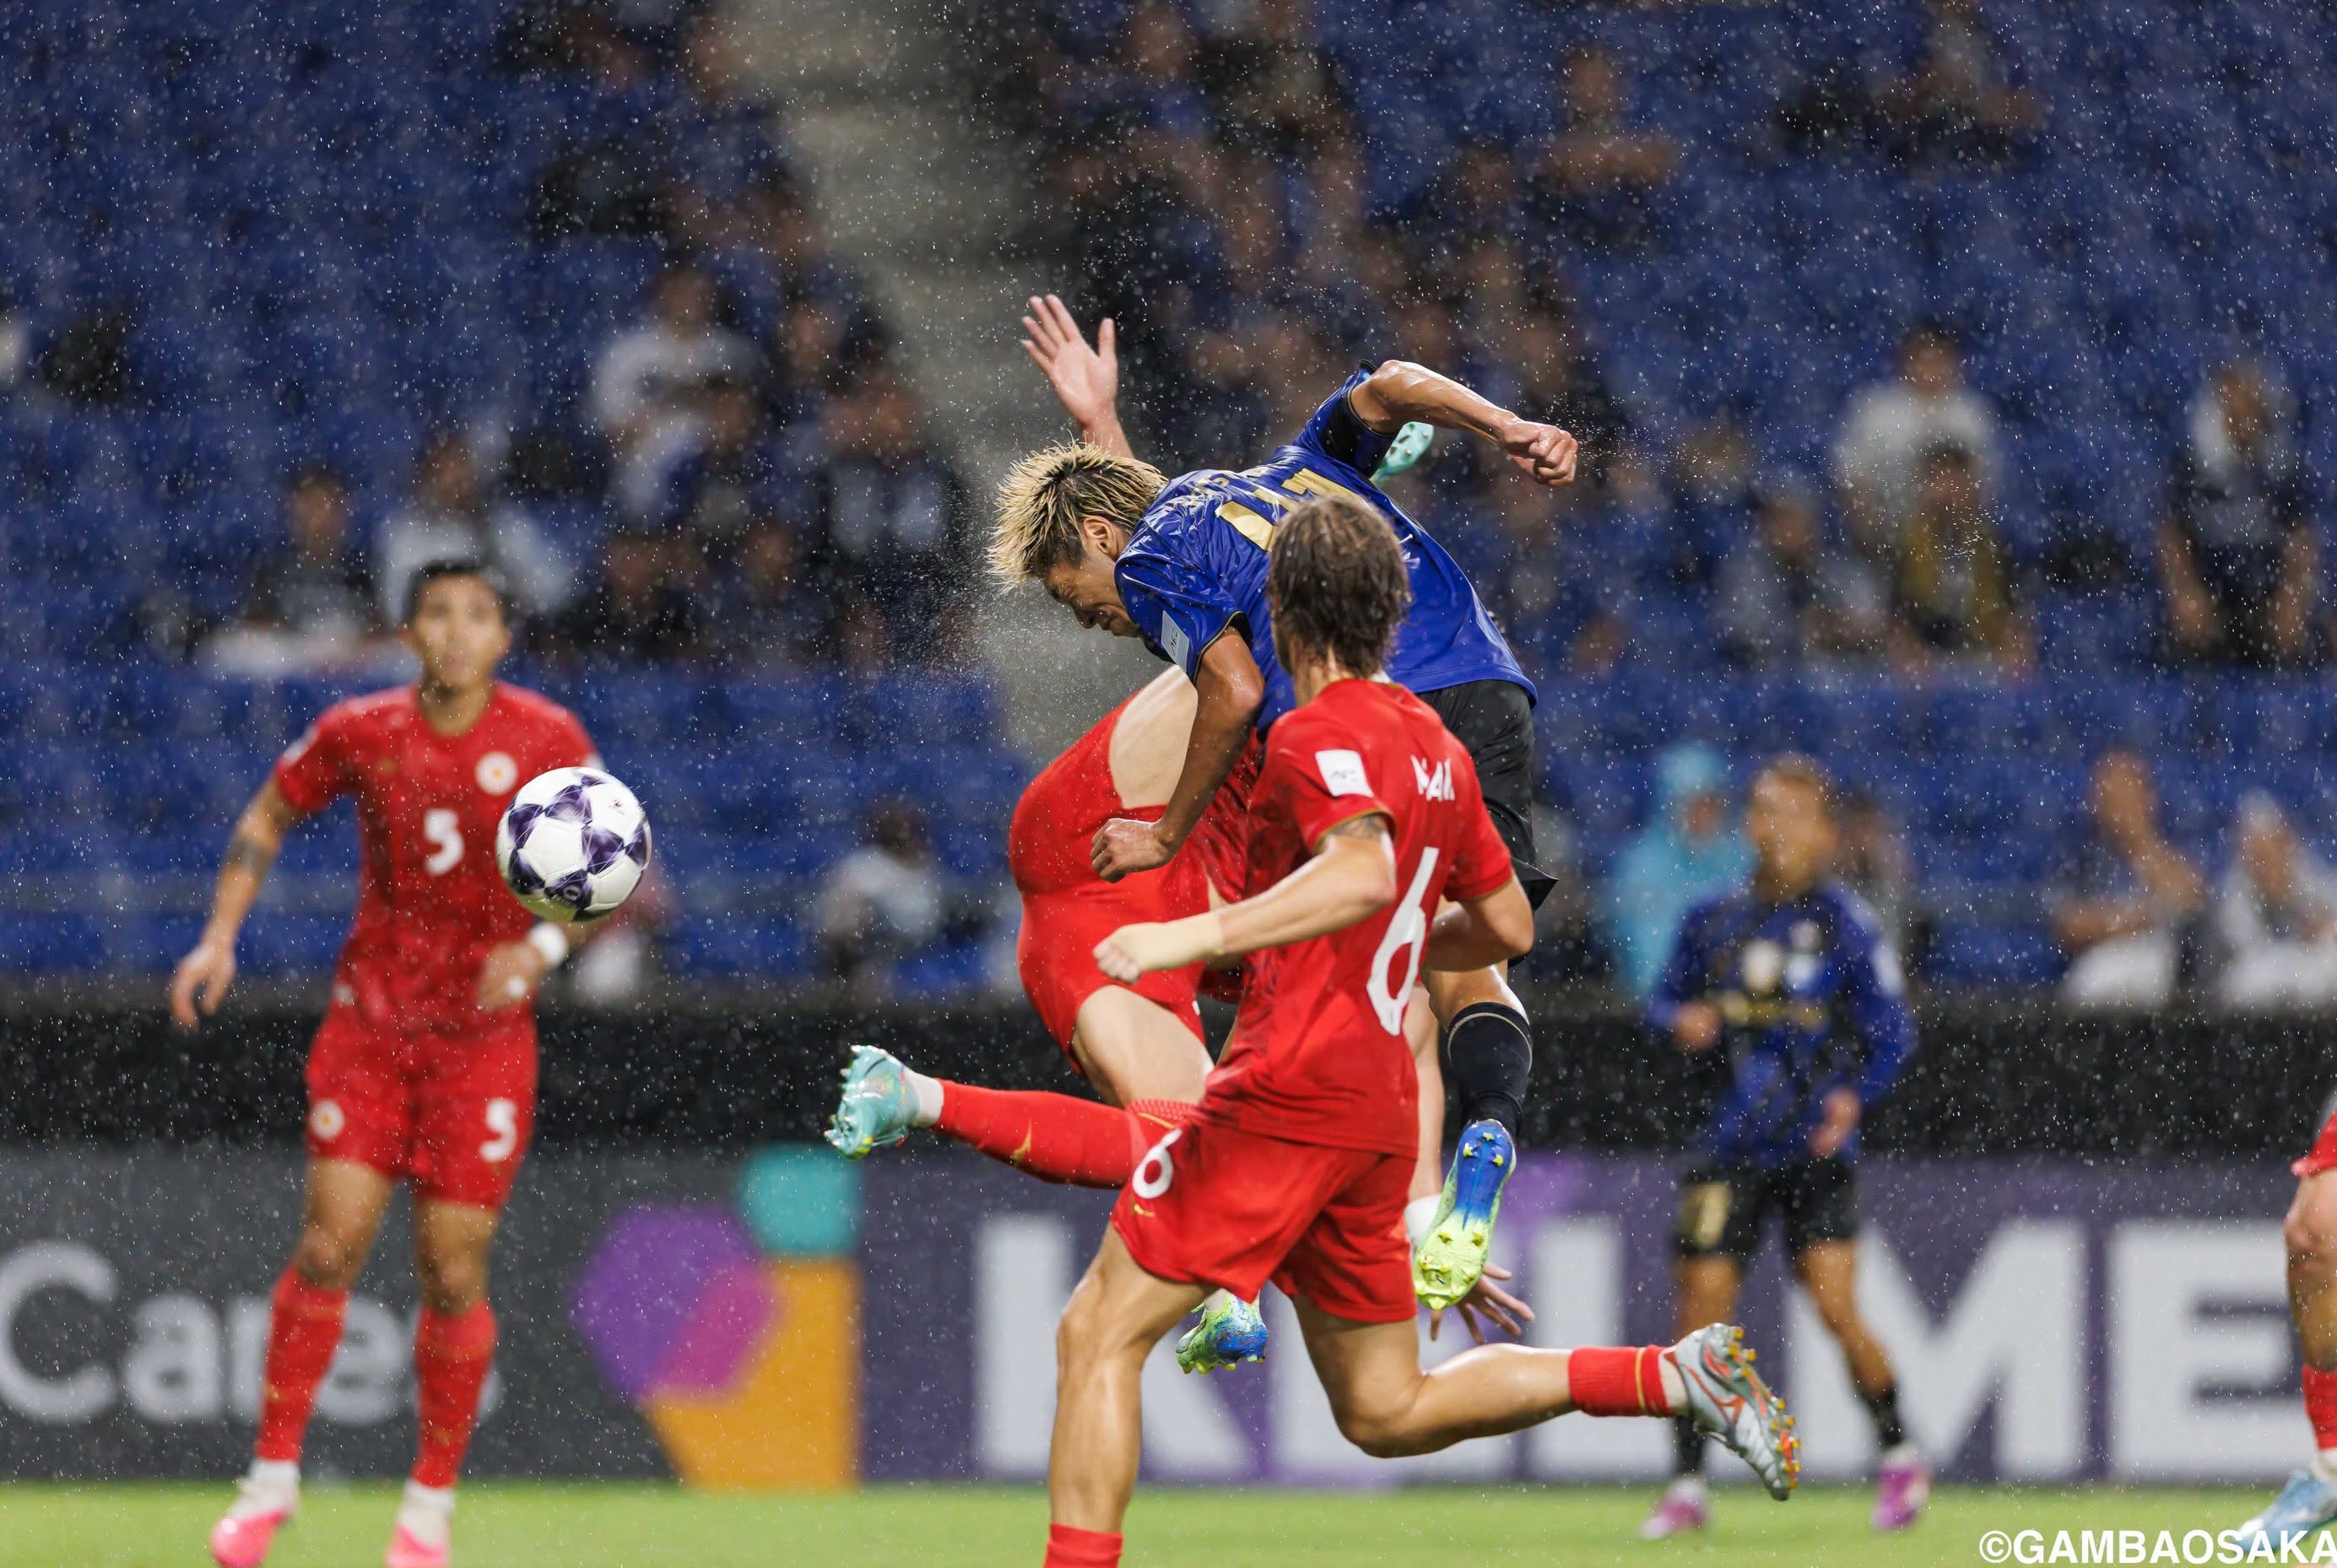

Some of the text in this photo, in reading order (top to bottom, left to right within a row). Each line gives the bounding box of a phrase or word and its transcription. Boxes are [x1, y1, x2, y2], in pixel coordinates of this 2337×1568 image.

[425, 808, 464, 874] 5
[1367, 846, 1439, 1035] 6
[479, 1097, 517, 1162] 5
[1132, 1128, 1182, 1199] 6
